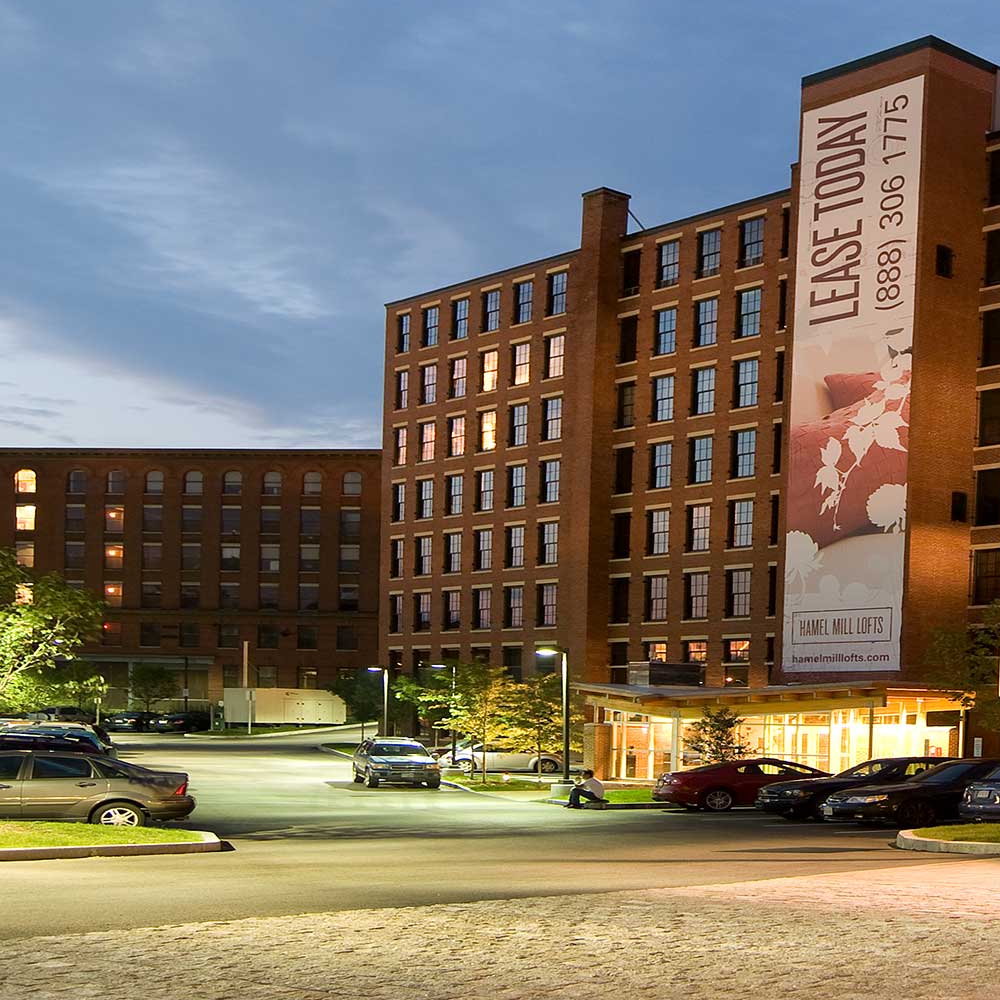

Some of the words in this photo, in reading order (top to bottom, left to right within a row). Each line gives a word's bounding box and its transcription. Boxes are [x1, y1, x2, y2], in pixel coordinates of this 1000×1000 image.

[882, 94, 909, 165] 1775
[813, 111, 868, 221] TODAY
[878, 175, 905, 230] 306
[809, 218, 863, 326] LEASE
[874, 239, 907, 311] (888)
[792, 653, 890, 664] hamelmilllofts.com
[800, 618, 829, 637] HAMEL
[832, 617, 853, 635] MILL
[857, 616, 884, 635] LOFTS
